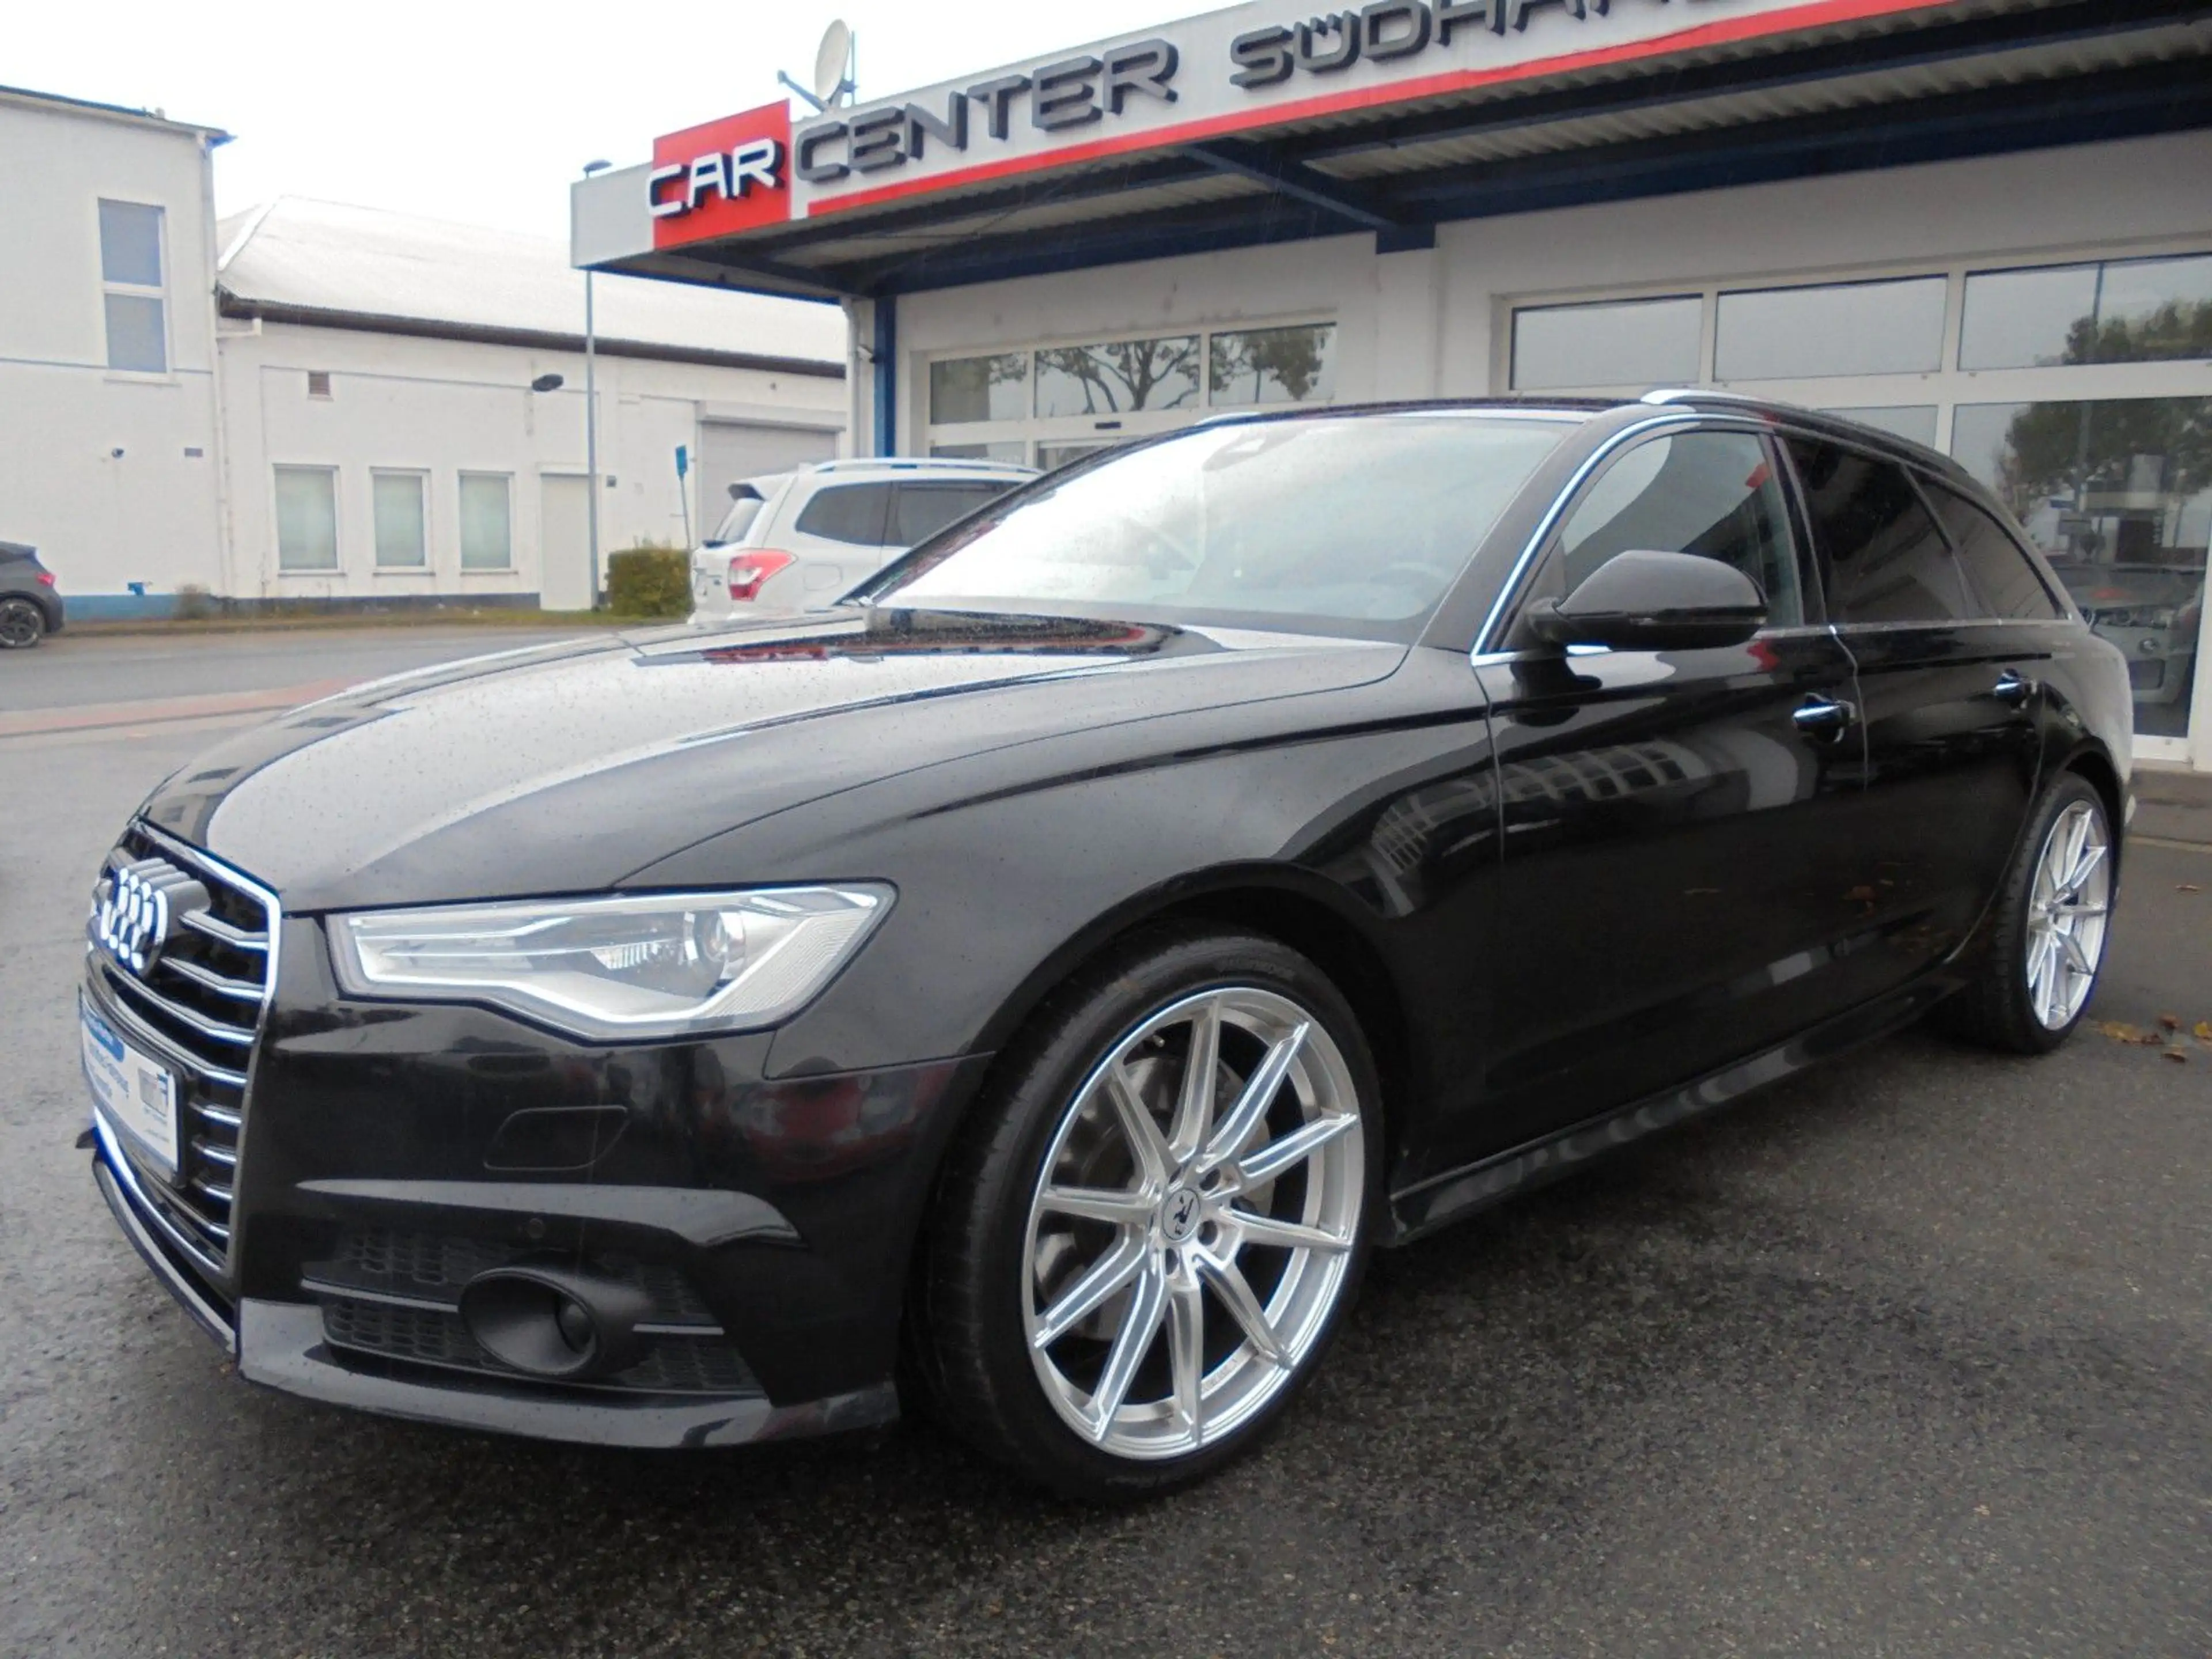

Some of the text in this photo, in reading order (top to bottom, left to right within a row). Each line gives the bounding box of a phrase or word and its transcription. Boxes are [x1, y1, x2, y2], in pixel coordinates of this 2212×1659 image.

[646, 0, 1666, 219] CAR CENTER SÜDH
